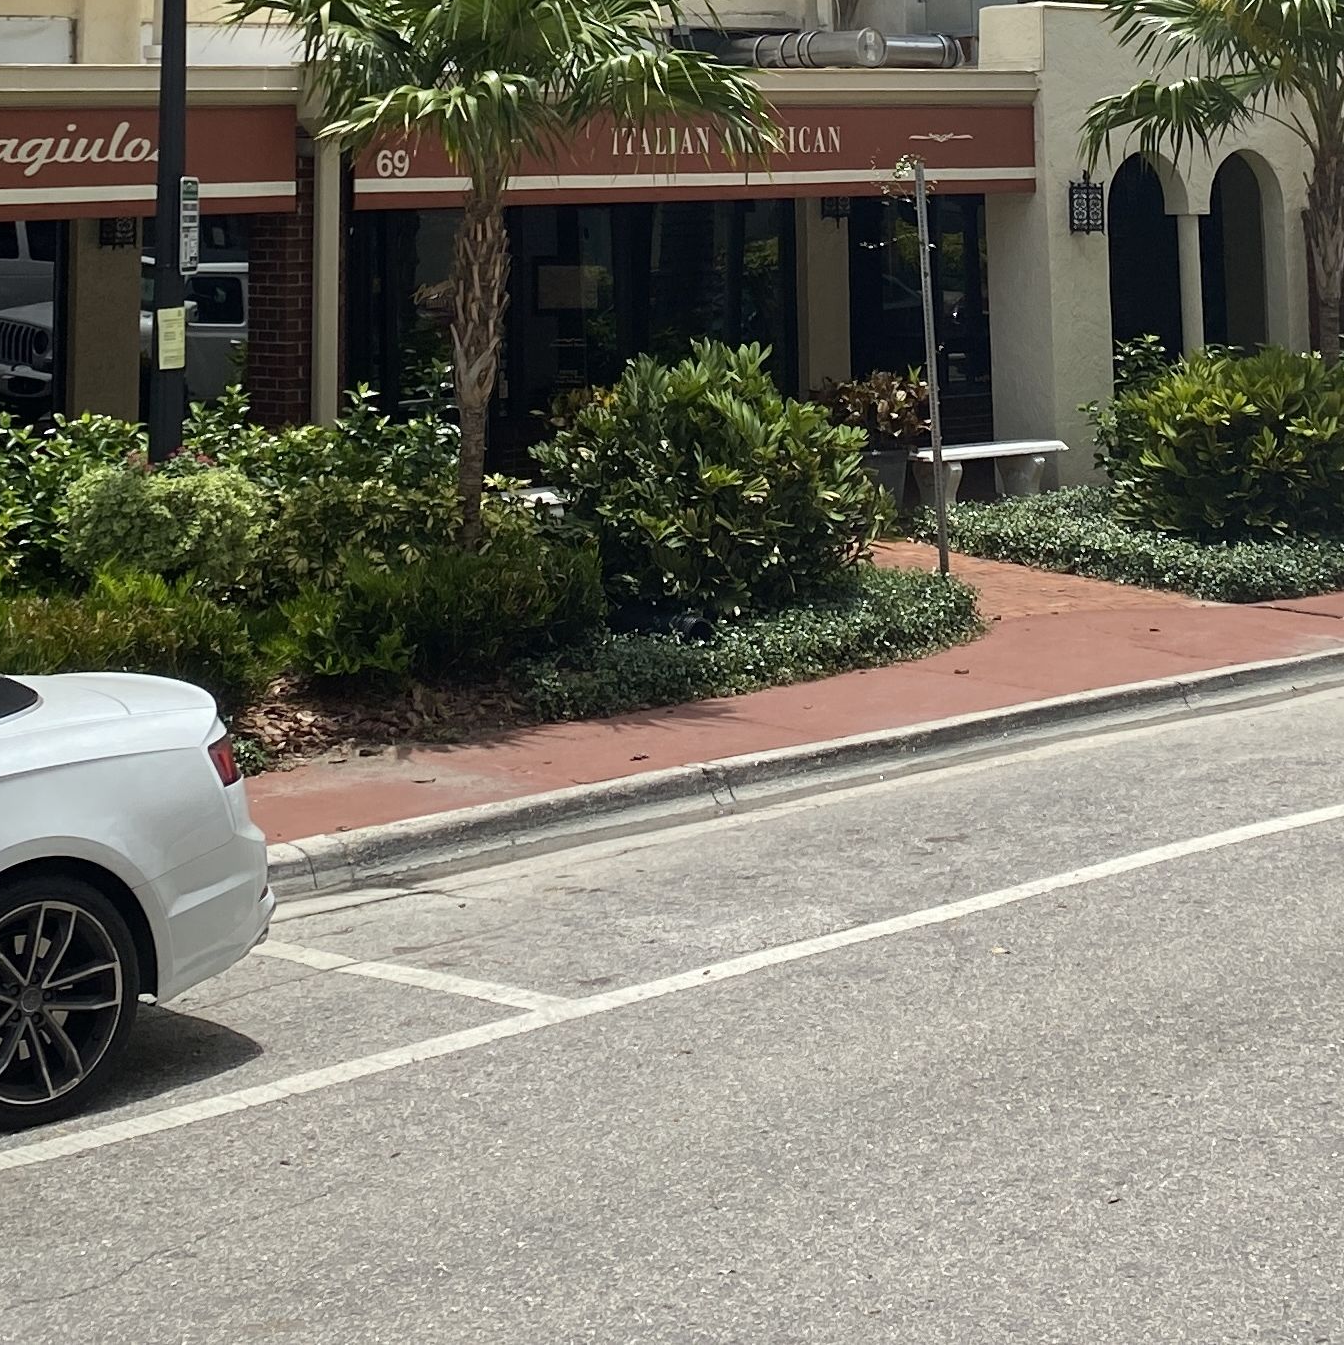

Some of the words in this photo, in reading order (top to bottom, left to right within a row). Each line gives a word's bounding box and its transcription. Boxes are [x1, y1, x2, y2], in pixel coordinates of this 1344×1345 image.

[610, 126, 710, 155] ITALIAN
[720, 125, 841, 154] AMRICAN
[376, 149, 410, 177] 69
